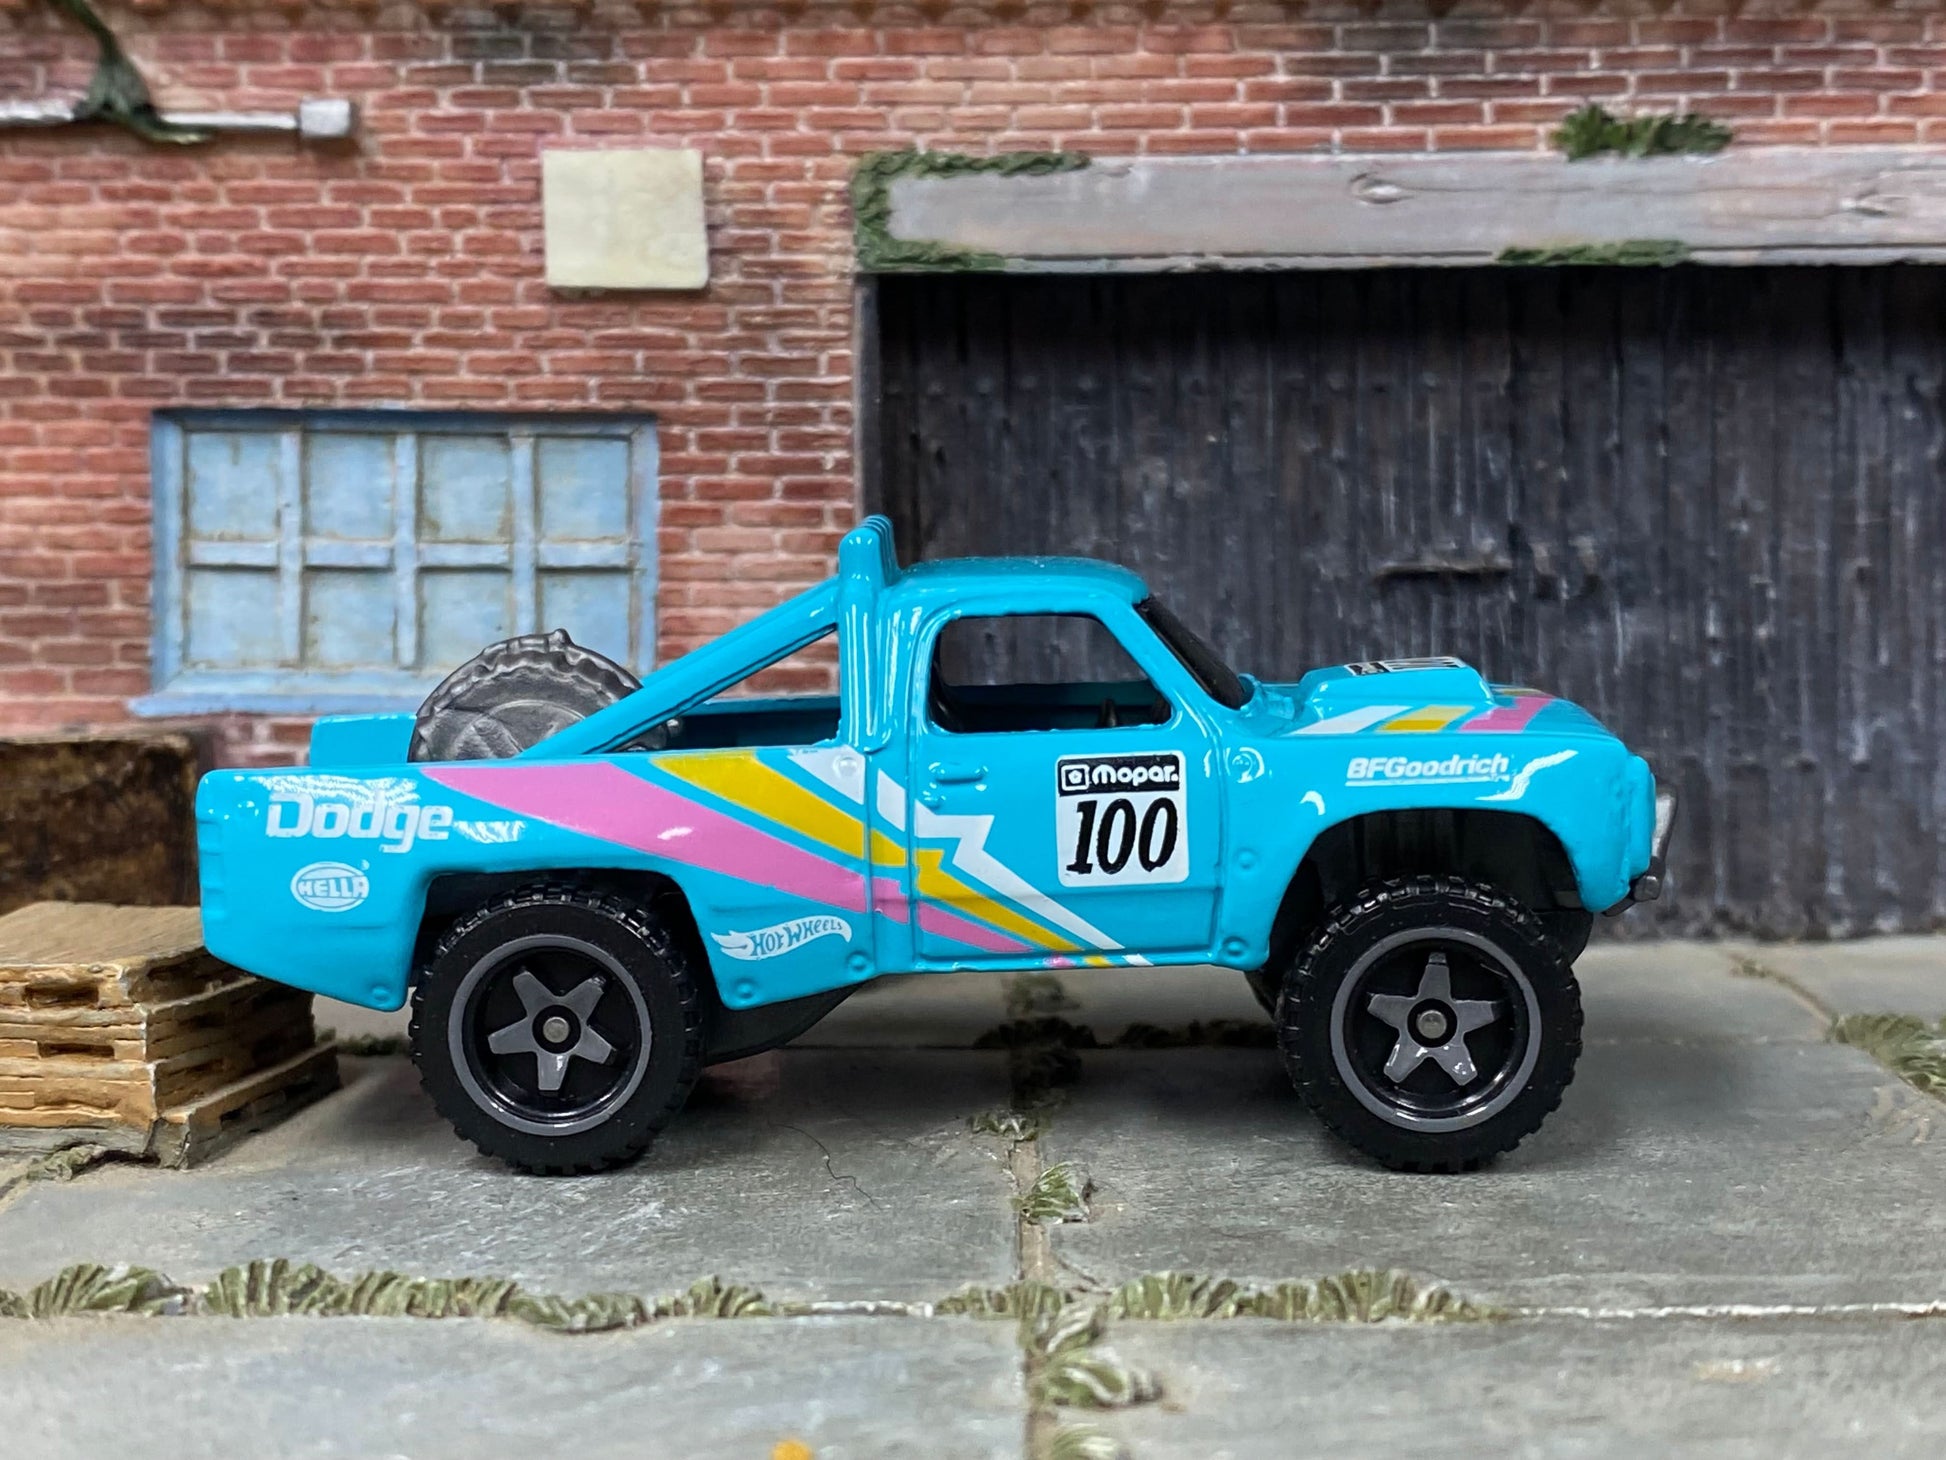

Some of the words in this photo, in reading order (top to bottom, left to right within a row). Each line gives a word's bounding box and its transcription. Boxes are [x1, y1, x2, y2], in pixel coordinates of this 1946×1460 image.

[1346, 752, 1510, 779] BFGoodrich
[265, 790, 454, 854] Dodge
[1066, 797, 1179, 875] 100
[297, 875, 369, 899] HELLA
